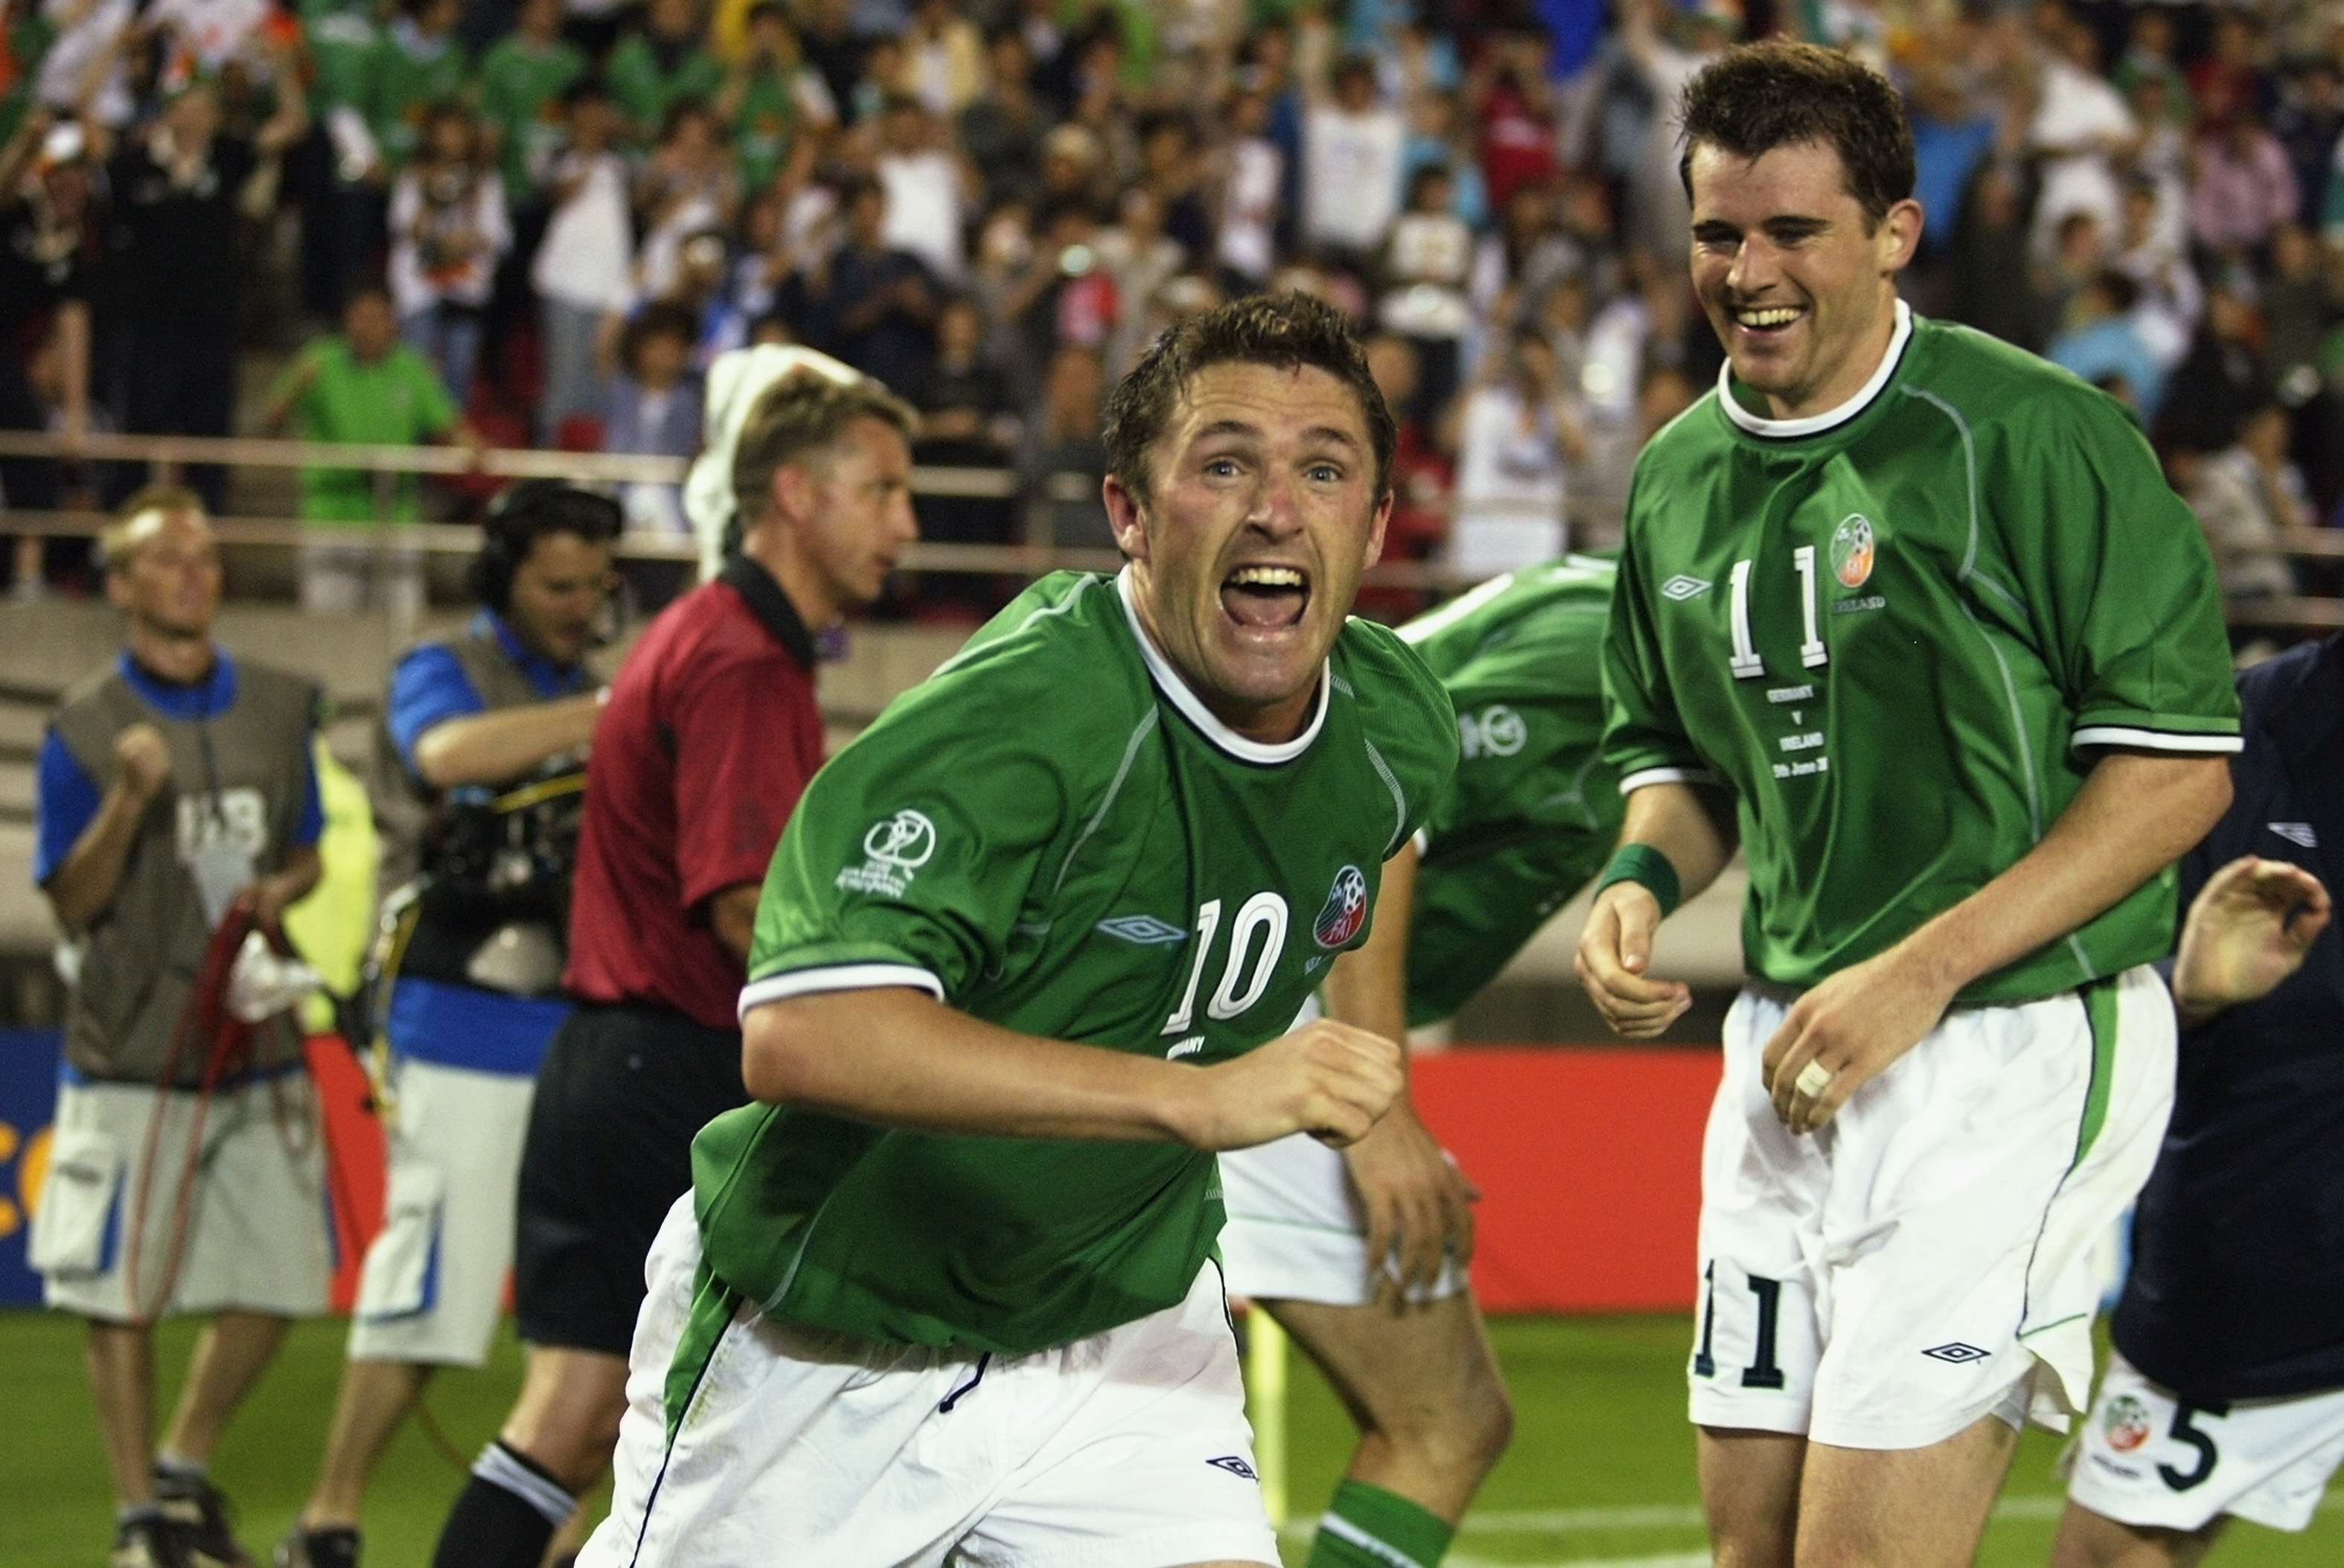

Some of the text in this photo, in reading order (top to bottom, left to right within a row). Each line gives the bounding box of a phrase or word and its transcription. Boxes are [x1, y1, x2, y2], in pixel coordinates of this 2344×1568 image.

[1730, 545, 1828, 679] 11
[1160, 891, 1288, 1036] 10
[1694, 1258, 1784, 1390] 11
[2157, 1396, 2232, 1493] 5
